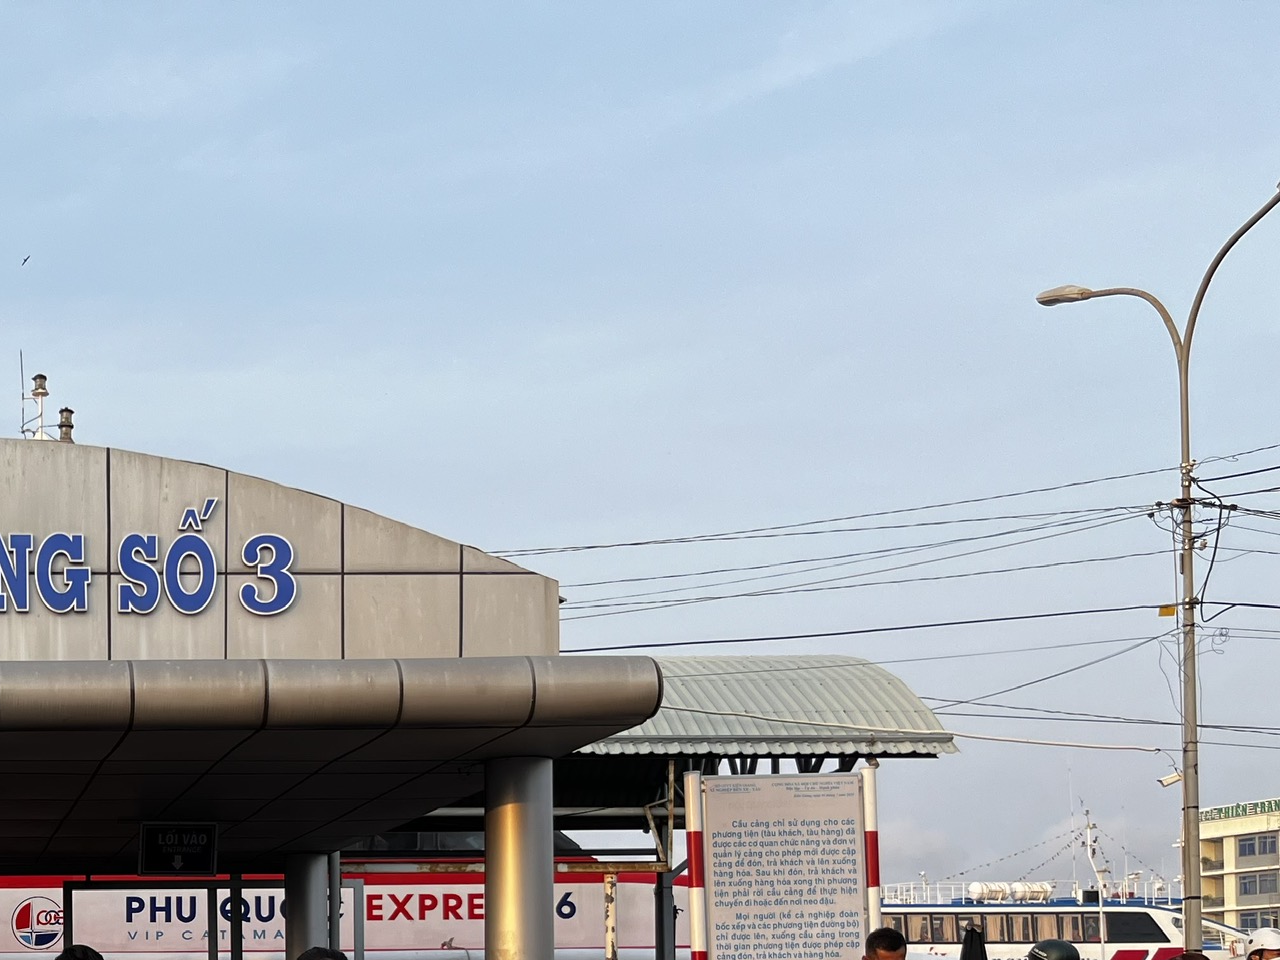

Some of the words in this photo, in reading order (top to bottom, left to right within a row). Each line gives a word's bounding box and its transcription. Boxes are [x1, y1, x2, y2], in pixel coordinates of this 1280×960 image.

[118, 498, 218, 614] SỐ
[239, 533, 297, 615] 3
[1253, 799, 1280, 815] TRAN
[732, 818, 748, 828] Cầu
[750, 818, 770, 830] cảng
[772, 818, 785, 827] chỉ
[788, 817, 798, 827] sử
[800, 818, 821, 829] dụng
[823, 817, 838, 826] cho
[841, 817, 855, 826] các
[712, 829, 742, 840] phương
[744, 829, 759, 839] tiện
[761, 828, 776, 838] (tàu
[778, 828, 804, 838] khách,
[806, 828, 819, 836] tàu
[820, 827, 844, 838] hàng)
[845, 827, 856, 835] đã
[712, 848, 732, 860] quản
[734, 849, 742, 860] lý
[743, 848, 763, 860] cảng
[764, 848, 780, 857] cho
[782, 848, 802, 859] phép
[803, 847, 818, 856] mới
[820, 847, 840, 858] được
[841, 847, 856, 858] cập
[712, 858, 733, 870] cảng
[734, 857, 745, 867] để
[746, 858, 765, 868] đón,
[766, 857, 778, 866] trả
[779, 857, 804, 866] khách
[806, 857, 816, 866] và
[817, 857, 830, 866] lên
[832, 855, 857, 868] xuống
[713, 868, 734, 880] hàng
[736, 868, 753, 877] hóa.
[755, 868, 771, 876] Sau
[773, 867, 785, 876] khi
[788, 867, 805, 877] đón,
[808, 866, 819, 875] trả
[821, 866, 845, 875] khách
[848, 866, 857, 875] và
[714, 878, 726, 887] lên
[728, 876, 753, 889] xuống
[754, 877, 775, 889] hàng
[776, 877, 792, 886] hóa
[793, 879, 813, 888] xong
[814, 876, 826, 885] thì
[827, 876, 858, 887] phương
[714, 888, 729, 899] tiện
[732, 888, 750, 899] phải
[752, 888, 764, 896] rời
[766, 886, 781, 896] cầu
[784, 886, 804, 898] cảng
[806, 885, 817, 896] để
[820, 886, 838, 897] thực
[840, 886, 858, 897] hiện
[125, 895, 197, 923] PHU
[366, 893, 485, 921] EXPRE
[555, 892, 577, 919] 6
[714, 896, 743, 909] chuyến
[744, 898, 752, 906] đi
[753, 897, 773, 908] hoặc
[773, 896, 789, 906] đến
[790, 897, 802, 906] nơi
[819, 896, 836, 907] đậu.
[736, 911, 750, 922] Mọi
[753, 911, 776, 922] người
[779, 909, 792, 920] (kể
[795, 910, 804, 919] cả
[808, 910, 836, 921] nghiệp
[839, 909, 859, 918] đoàn
[128, 930, 164, 941] VIP
[716, 931, 728, 940] chỉ
[731, 931, 751, 942] được
[754, 931, 768, 941] lên,
[771, 929, 796, 942] xuống
[798, 929, 813, 939] cầu
[816, 929, 836, 941] cảng
[838, 930, 860, 941] trong
[716, 942, 732, 950] thời
[733, 941, 751, 952] gian
[752, 941, 783, 952] phương
[785, 940, 800, 951] tiện
[802, 940, 822, 951] được
[823, 940, 844, 951] phép
[845, 939, 860, 950] cập
[737, 951, 755, 960] đón,
[756, 950, 767, 959] trả
[768, 950, 792, 959] khách
[793, 950, 803, 959] và
[803, 950, 824, 960] hàng
[824, 949, 842, 958] hóa.
